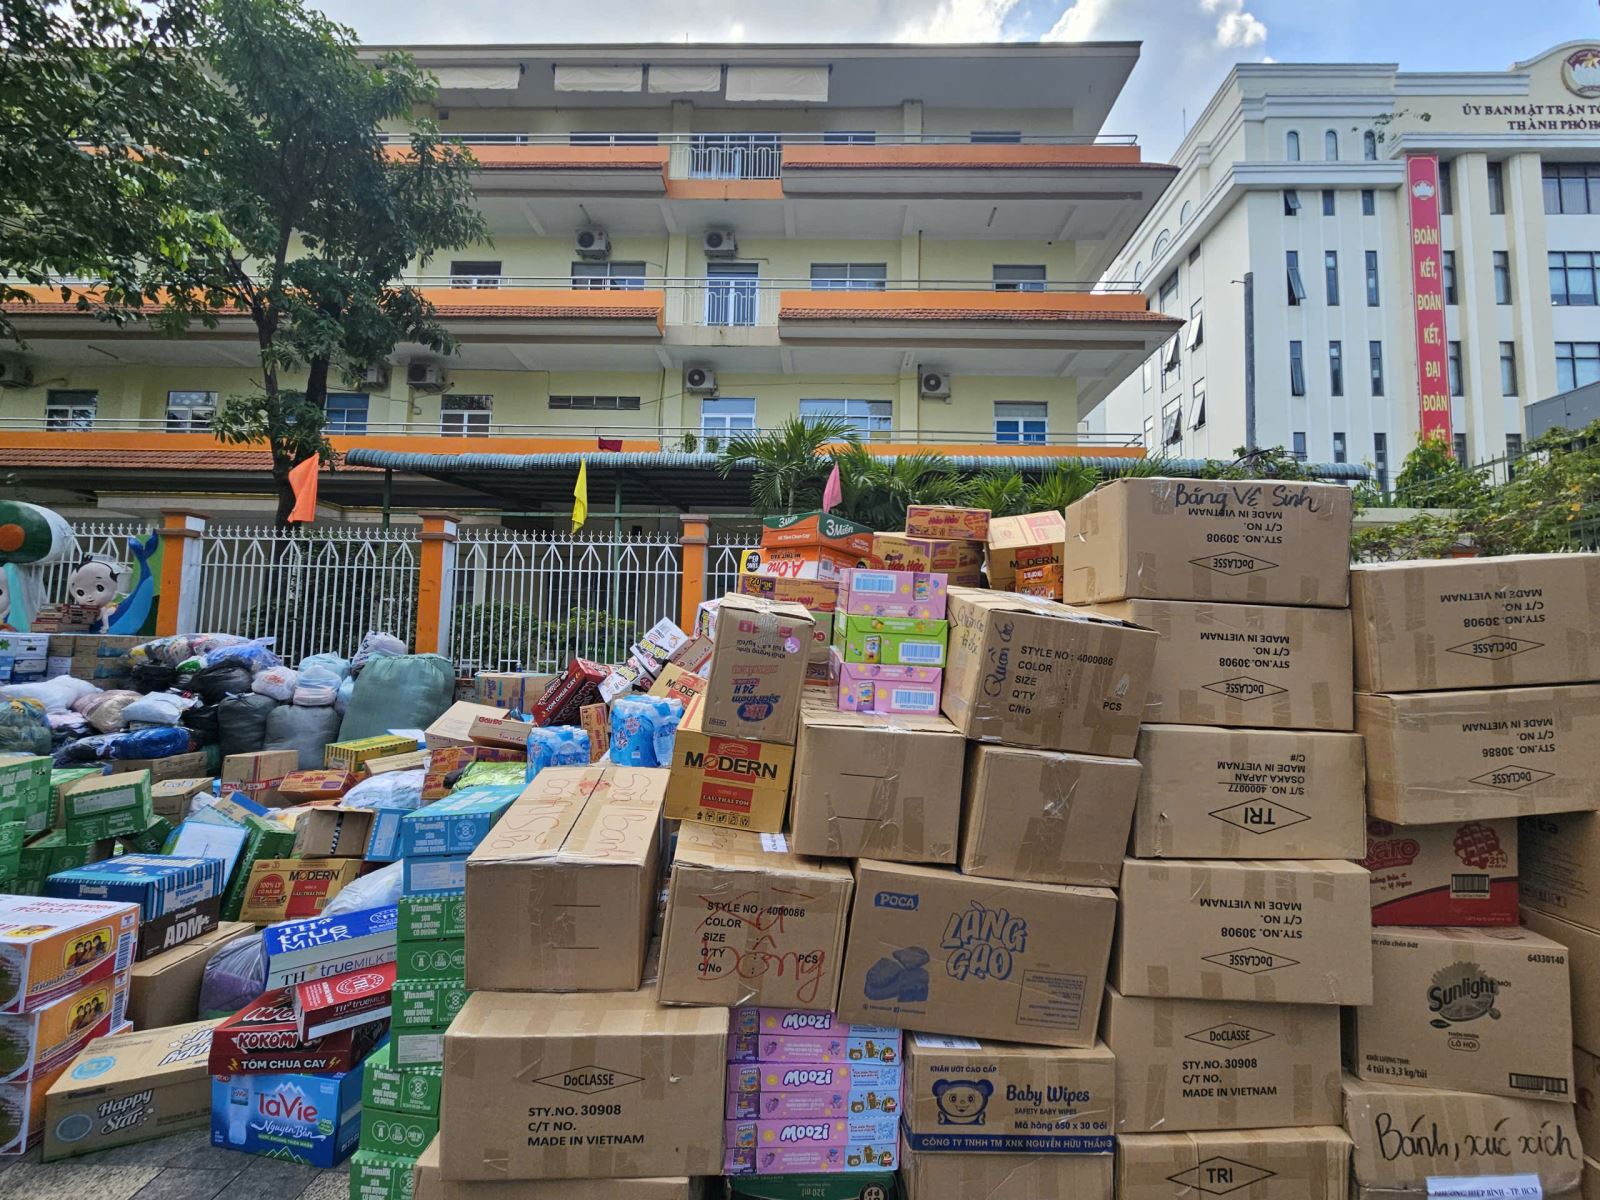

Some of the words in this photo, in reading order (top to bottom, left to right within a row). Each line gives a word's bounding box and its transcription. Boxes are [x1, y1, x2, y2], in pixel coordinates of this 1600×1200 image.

[1508, 118, 1557, 130] THÀNH
[1561, 118, 1586, 130] PHỐ
[1414, 228, 1438, 245] ĐOÀN
[1417, 294, 1440, 310] ĐOÀN
[1426, 362, 1440, 382] ĐẠI
[1423, 394, 1448, 412] ĐOÀN
[1272, 486, 1320, 512] Sinh
[1188, 507, 1234, 518] VIETNAM
[1238, 510, 1248, 518] IN
[1252, 511, 1283, 520] MADE
[1244, 522, 1262, 531] NO.
[1266, 522, 1282, 532] C/T
[1206, 533, 1239, 543] 30908
[1213, 558, 1254, 570] DoCLASSE
[1440, 592, 1492, 602] VIETNAM
[1495, 590, 1507, 599] IN
[1509, 588, 1542, 598] MADE
[1502, 602, 1524, 612] NO.
[1526, 602, 1544, 610] C/T
[1464, 618, 1500, 628] 30908
[1472, 642, 1518, 654] DoCLASSE
[1021, 646, 1052, 658] STYLE
[1054, 651, 1068, 660] NO
[1077, 654, 1114, 666] 4000086
[1018, 661, 1052, 672] COLOR
[1015, 675, 1037, 686] SIZE
[734, 684, 742, 694] H
[742, 684, 756, 694] 24
[1012, 690, 1036, 700] Q'TY
[1008, 704, 1031, 715] C/No
[1103, 702, 1122, 712] PCS
[1482, 746, 1514, 758] 30886
[684, 750, 778, 780] MODERN
[1217, 761, 1262, 772] VIETNAM
[1264, 764, 1274, 772] IN
[1276, 764, 1306, 773] MADE
[1234, 773, 1267, 782] JAPAN
[1269, 774, 1305, 784] OSAKA
[1228, 784, 1266, 794] 4000077
[1269, 786, 1286, 795] NO.
[1286, 786, 1305, 796] S/T
[1244, 806, 1276, 825] TRI
[288, 870, 340, 881] MODERN
[880, 892, 916, 908] POCA
[707, 902, 740, 914] STYLE
[742, 904, 758, 914] NO
[766, 906, 805, 918] 4000086
[706, 918, 742, 928] COLOR
[163, 917, 202, 948] ADM
[278, 925, 348, 944] true
[704, 932, 726, 942] SIZE
[282, 933, 352, 952] MILK
[701, 948, 726, 958] Q'TY
[798, 954, 818, 964] PCS
[1527, 954, 1564, 964] 64330140
[698, 964, 722, 973] C/No
[280, 971, 305, 985] TH
[1428, 977, 1496, 1012] Sunlight
[1209, 1030, 1250, 1041] DoCLASSE
[269, 1059, 300, 1069] CHUA
[304, 1059, 327, 1068] CAY
[983, 1064, 997, 1073] CẤP
[1224, 1058, 1258, 1068] 30908
[1391, 1066, 1403, 1077] 3,3
[1404, 1068, 1428, 1078] kg/túi
[564, 1074, 614, 1086] DoCLASSE
[1182, 1075, 1200, 1085] C/T
[1202, 1074, 1222, 1083] NO.
[1006, 1084, 1042, 1107] Baby
[1046, 1086, 1090, 1107] Wipes
[1182, 1088, 1213, 1098] MADE
[1216, 1088, 1228, 1097] IN
[1230, 1086, 1277, 1097] VIETNAM
[98, 1088, 154, 1118] Happy
[580, 1104, 621, 1116] 30908
[100, 1106, 144, 1135] Star
[1015, 1121, 1028, 1129] Mã
[1031, 1121, 1052, 1131] hàng
[1055, 1122, 1070, 1130] 650
[1080, 1122, 1091, 1130] 30
[1093, 1121, 1108, 1130] Gói
[528, 1121, 550, 1133] C/T
[553, 1122, 576, 1131] NO.
[528, 1136, 566, 1147] MADE
[570, 1136, 583, 1145] IN
[586, 1134, 644, 1144] VIETNAM
[922, 1137, 950, 1146] CÔNG
[965, 1139, 988, 1147] TNHH
[1375, 1112, 1459, 1161] Bánh,
[1464, 1117, 1510, 1157] xúc
[1518, 1120, 1577, 1160] xích
[1206, 1168, 1233, 1184] TRI
[812, 1188, 825, 1197] 320
